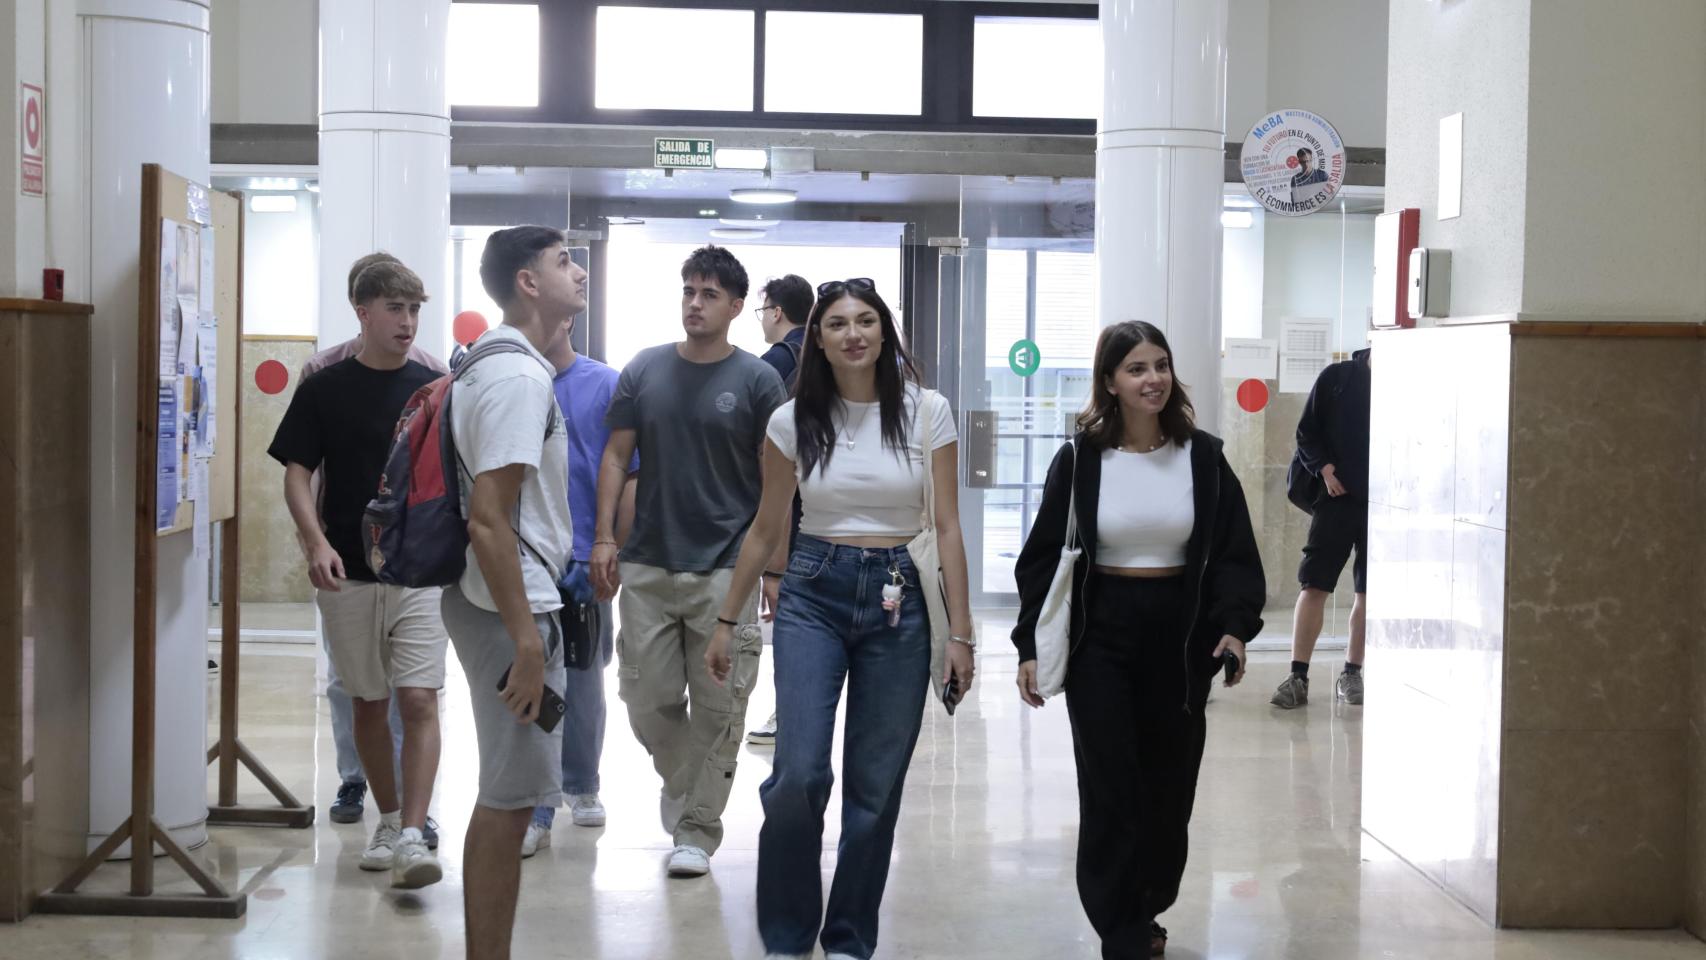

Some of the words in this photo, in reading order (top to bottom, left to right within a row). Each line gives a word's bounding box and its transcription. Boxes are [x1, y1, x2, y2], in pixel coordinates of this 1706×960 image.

[1252, 114, 1284, 140] MeBA
[659, 141, 690, 153] SALIDA
[697, 142, 709, 153] DE
[1267, 130, 1287, 147] FUTURO
[1288, 129, 1297, 137] EN
[1297, 129, 1304, 139] EL
[1304, 133, 1321, 150] PUNTO
[1316, 149, 1325, 158] DE
[657, 154, 711, 166] EMERGENCIA
[1256, 187, 1266, 200] EL
[1265, 195, 1317, 212] ECOMMERCE
[1314, 191, 1327, 204] ES
[1323, 183, 1335, 196] LA
[1329, 153, 1342, 184] SALIDA
